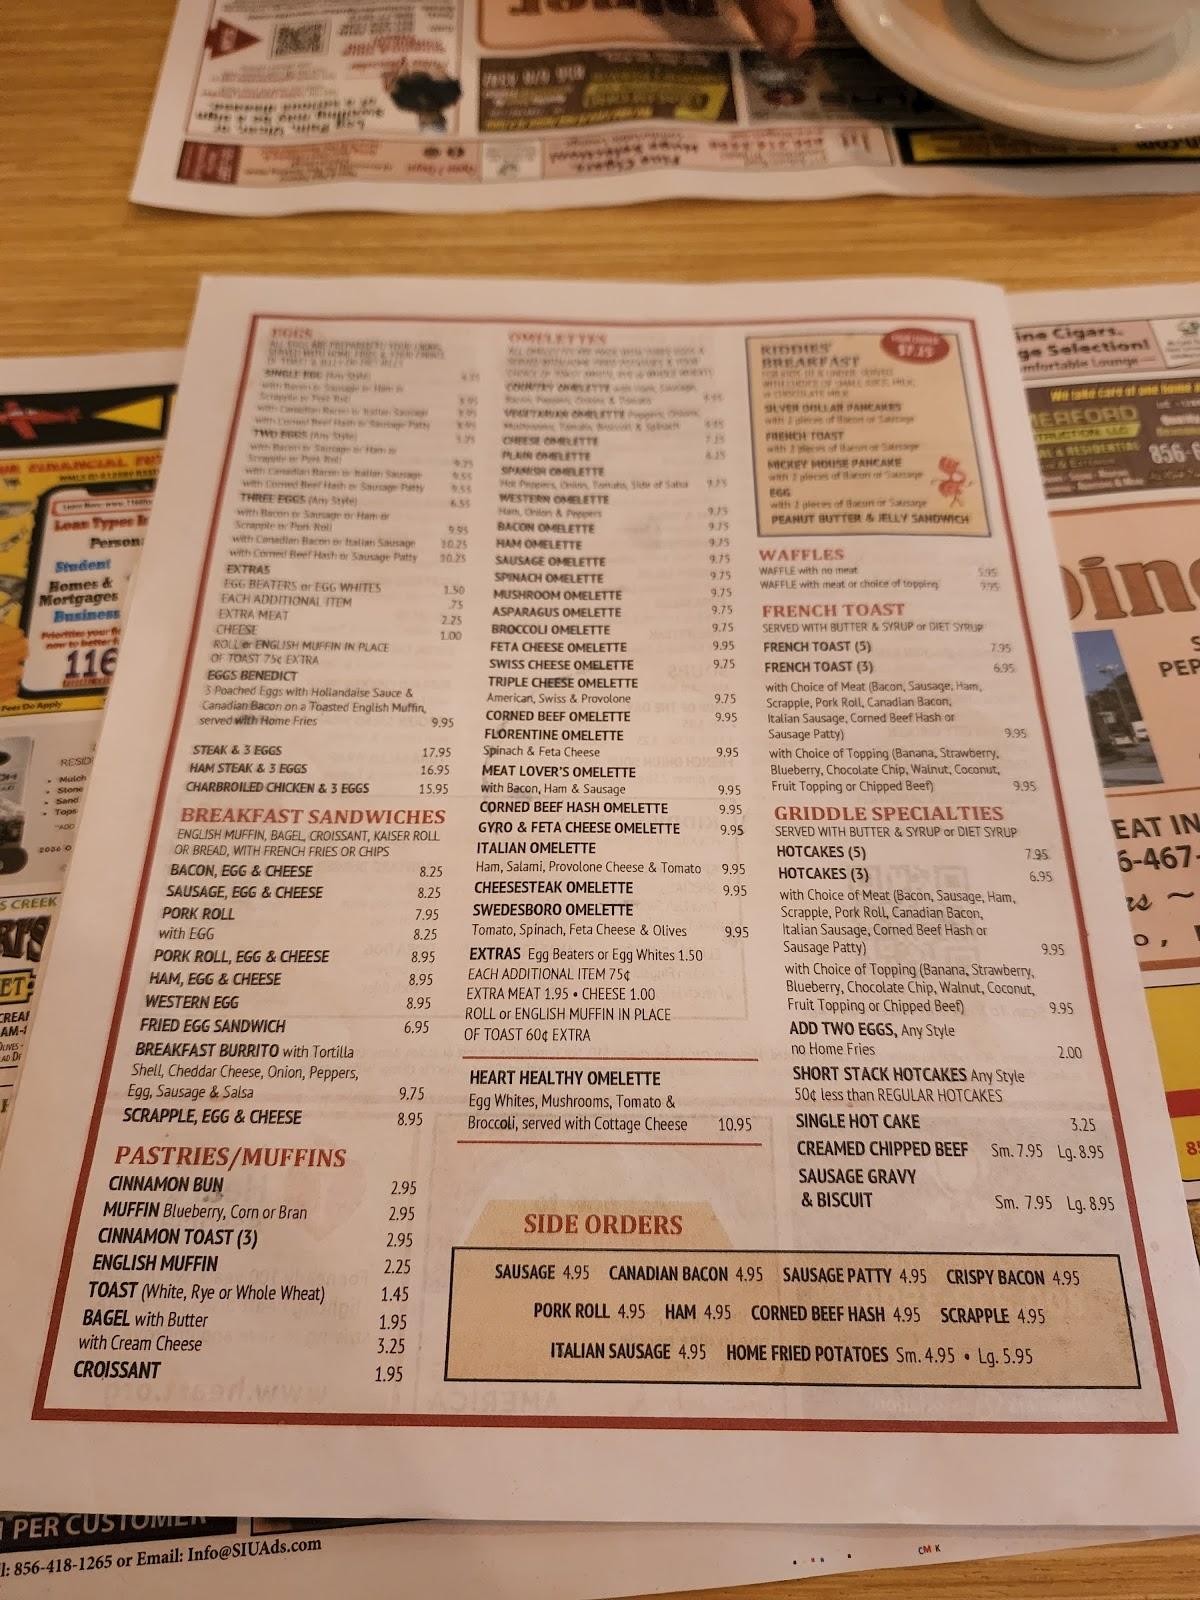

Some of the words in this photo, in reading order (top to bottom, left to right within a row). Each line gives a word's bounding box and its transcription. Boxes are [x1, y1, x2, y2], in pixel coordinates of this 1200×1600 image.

[544, 437, 598, 446] OMELETTE
[499, 494, 550, 504] WESTERN
[554, 495, 609, 504] OMELETTE
[772, 514, 815, 525] PEANUT
[819, 514, 862, 524] BUTTER
[911, 513, 970, 524] SANDWICH
[497, 522, 535, 532] BACON
[538, 523, 595, 534] OMELETTE
[759, 549, 845, 562] WAFFLES
[55, 559, 111, 573] Student
[759, 567, 796, 575] WAFFLE
[799, 566, 818, 575] with
[315, 582, 337, 592] EGG
[340, 582, 382, 593] WHITES
[39, 591, 119, 608] Mortgages
[54, 609, 120, 624] Business
[493, 607, 560, 618] ASPARAGUS
[562, 608, 622, 618] OMELETTE
[711, 605, 733, 615] 9.75
[762, 605, 837, 618] FRENCH
[842, 603, 905, 616] TOAST
[207, 670, 237, 681] EGGS
[240, 671, 298, 682] BENEDICT
[488, 676, 528, 688] TRIPLE
[532, 677, 575, 688] CHEESE
[578, 678, 639, 689] OMELETTE
[487, 693, 536, 705] American,
[539, 694, 566, 704] Swiss
[570, 694, 578, 704] &
[581, 694, 631, 704] Provolone
[714, 694, 737, 704] 9.75
[193, 745, 227, 755] STEAK
[231, 745, 240, 755] &
[244, 745, 250, 755] 3
[254, 745, 282, 756] EGGS
[423, 748, 451, 758] 17.95
[181, 808, 304, 823] BREAKFAST
[309, 809, 446, 824] SANDWICHES
[775, 806, 867, 821] GRIDDLE
[872, 806, 1004, 821] SPECIALTIES
[170, 864, 217, 878] BACON,
[222, 865, 247, 877] EGG
[251, 865, 261, 877] &
[265, 865, 313, 878] CHEESE
[419, 866, 443, 878] 8.25
[779, 867, 847, 880] HOTCAKES
[851, 867, 870, 883] (3)
[475, 881, 562, 894] CHEESESTEAK
[566, 881, 634, 894] OMELETTE
[723, 885, 747, 896] 9.95
[472, 923, 516, 937] Tomato,
[519, 923, 566, 938] Spinach,
[569, 923, 593, 936] Feta
[596, 923, 636, 936] Cheese
[640, 924, 649, 936] &
[653, 924, 687, 937] Olives
[787, 980, 844, 996] Blueberry,
[847, 981, 904, 994] Chocolate
[908, 981, 937, 996] Chip,
[941, 981, 985, 996] Walnut,
[987, 982, 1035, 997] Coconut,
[140, 1018, 180, 1032] FRIED
[183, 1019, 210, 1032] EGG
[214, 1019, 286, 1033] SANDWICH
[404, 1021, 429, 1034] 6.95
[131, 1063, 164, 1079] Shell,
[168, 1064, 217, 1078] Cheddar
[220, 1064, 264, 1080] Cheese,
[268, 1065, 306, 1081] Onion,
[309, 1066, 359, 1083] Peppers,
[470, 1070, 516, 1085] HEART
[520, 1070, 583, 1086] HEALTHY
[587, 1071, 661, 1086] OMELETTE
[796, 1113, 845, 1129] SINGLE
[849, 1114, 879, 1129] HOT
[883, 1114, 920, 1129] CAKE
[1070, 1117, 1096, 1132] 3.25
[114, 1146, 347, 1171] PASTRIES/MUFFINS
[103, 1201, 160, 1217] MUFFIN
[163, 1203, 227, 1222] Blueberry,
[230, 1204, 260, 1220] Corn
[263, 1209, 276, 1220] or
[279, 1205, 308, 1220] Bran
[388, 1206, 415, 1221] 2.95
[524, 1214, 579, 1234] SIDE
[585, 1214, 683, 1235] ORDERS
[495, 1264, 555, 1280] SAUSAGE
[563, 1265, 590, 1280] 4.95
[609, 1265, 679, 1281] CANADIAN
[682, 1266, 729, 1282] BACON
[736, 1267, 763, 1282] 4.95
[783, 1267, 845, 1283] SAUSAGE
[847, 1268, 892, 1284] PATTY
[900, 1269, 927, 1284] 4.95
[946, 1269, 994, 1286] CRISPY
[998, 1270, 1046, 1286] BACON
[1052, 1271, 1080, 1286] 4.95
[88, 1281, 139, 1298] TOAST
[142, 1283, 187, 1304] (White,
[191, 1284, 215, 1304] Rye
[219, 1289, 232, 1300] or
[236, 1284, 277, 1301] Whole
[281, 1285, 325, 1305] Wheat)
[381, 1286, 409, 1302] 1.45
[551, 1342, 605, 1359] ITALIAN
[609, 1343, 671, 1360] SAUSAGE
[678, 1344, 706, 1360] 4.95
[727, 1344, 768, 1361] HOME
[772, 1345, 811, 1362] FRIED
[815, 1346, 889, 1362] POTATOES
[896, 1347, 921, 1363] Sm.
[925, 1347, 955, 1364] 4.95
[978, 1348, 998, 1368] Lg.
[1003, 1348, 1033, 1364] 5.95
[74, 1361, 161, 1379] CROISSANT
[374, 1366, 403, 1383] 1.95
[13, 1518, 59, 1540] PER
[14, 1555, 112, 1577] 856-418-1265
[117, 1557, 133, 1568] or
[137, 1548, 184, 1567] Email:
[188, 1539, 322, 1561] Info@SIUAds.com
